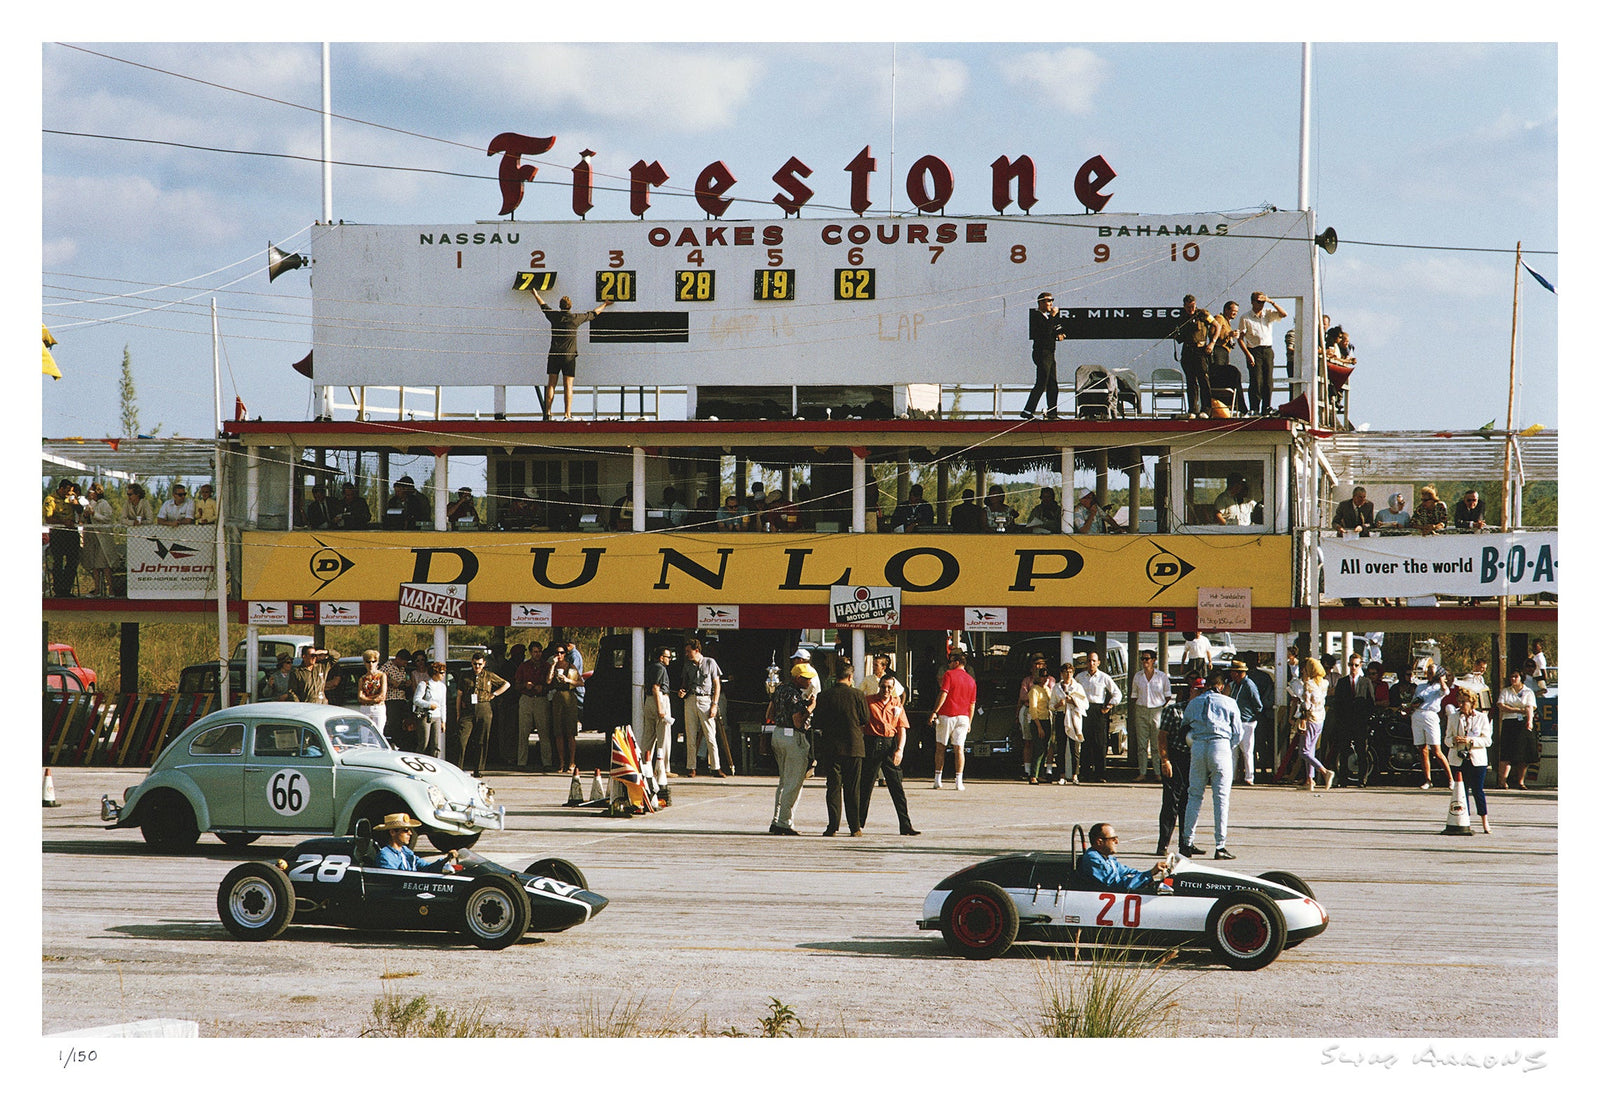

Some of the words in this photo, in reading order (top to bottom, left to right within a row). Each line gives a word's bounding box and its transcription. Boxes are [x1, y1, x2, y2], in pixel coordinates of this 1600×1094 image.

[487, 132, 1118, 217] Firestone
[420, 233, 520, 245] NASSAU
[648, 226, 784, 247] OAKES
[821, 223, 987, 245] COURSE
[1098, 223, 1229, 237] BAHAMAS
[457, 251, 462, 268] 1
[530, 250, 545, 268] 2
[608, 250, 624, 268] 3
[687, 249, 704, 267] 4
[767, 248, 783, 267] 5
[847, 247, 864, 266] 6
[928, 246, 944, 264] 7
[1010, 244, 1027, 264] 8
[1093, 243, 1110, 262] 9
[1171, 242, 1200, 262] 10
[601, 272, 630, 300] 20
[680, 271, 711, 300] 28
[762, 271, 788, 299] 19
[840, 270, 870, 299] 62
[1088, 309, 1130, 318] MIN.
[877, 313, 925, 341] LAP
[131, 563, 214, 573] Johnson
[410, 547, 1084, 593] DUNLOP
[1341, 558, 1360, 574] All
[1365, 563, 1398, 574] over
[1403, 558, 1428, 574] the
[1433, 557, 1473, 573] world
[401, 587, 464, 618] MARFAK
[836, 597, 892, 616] HAVOLINE
[403, 612, 454, 624] Lubrication
[846, 613, 870, 621] MOTOR
[401, 756, 437, 773] 66
[272, 773, 303, 811] 66
[288, 853, 351, 883] 28
[402, 882, 430, 891] BEACH
[432, 884, 454, 893] TEAM
[1180, 880, 1203, 889] FITCH
[1205, 882, 1232, 891] SPRINT
[1096, 893, 1142, 927] 20
[59, 1046, 98, 1069] 1/150
